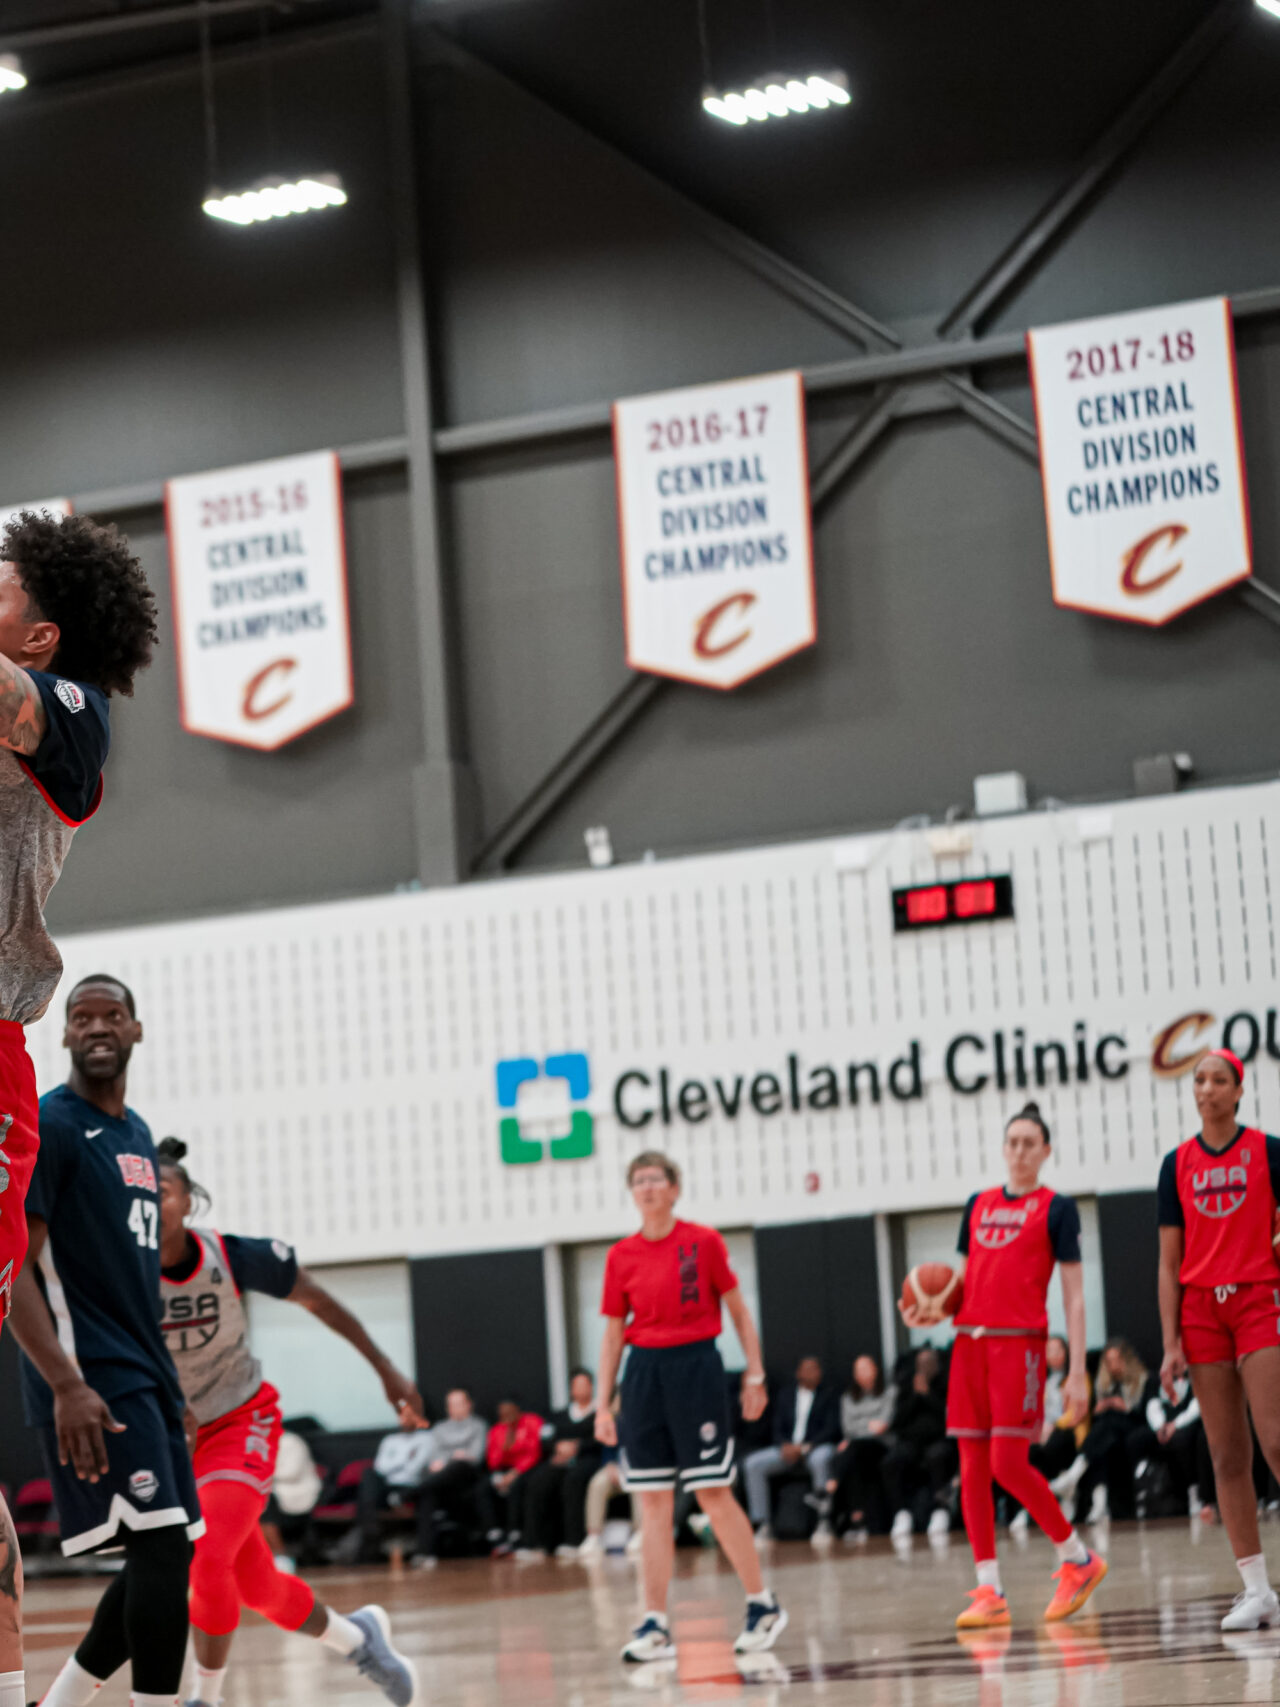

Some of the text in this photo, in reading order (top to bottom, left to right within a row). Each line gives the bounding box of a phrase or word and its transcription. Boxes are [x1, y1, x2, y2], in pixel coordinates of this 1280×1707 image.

[1067, 330, 1195, 380] 2017-18
[1078, 381, 1194, 428] CENTRAL
[647, 405, 769, 452] 2016-17
[1083, 424, 1196, 470] DIVISION
[657, 454, 766, 498] CENTRAL
[1067, 463, 1220, 516] CHAMPIONS
[201, 480, 308, 528] 2015-16
[660, 496, 769, 538] DIVISION
[208, 526, 306, 572] CENTRAL
[644, 534, 789, 582] CHAMPIONS
[212, 567, 308, 608] DIVISION
[198, 600, 327, 651] CHAMPIONS
[613, 1040, 922, 1129] Cleveland
[945, 1020, 1130, 1095] Clinic
[116, 1153, 157, 1193] USA
[1193, 1166, 1247, 1190] USA
[127, 1198, 158, 1250] 47
[981, 1208, 1027, 1225] USA
[161, 1293, 220, 1319] SA
